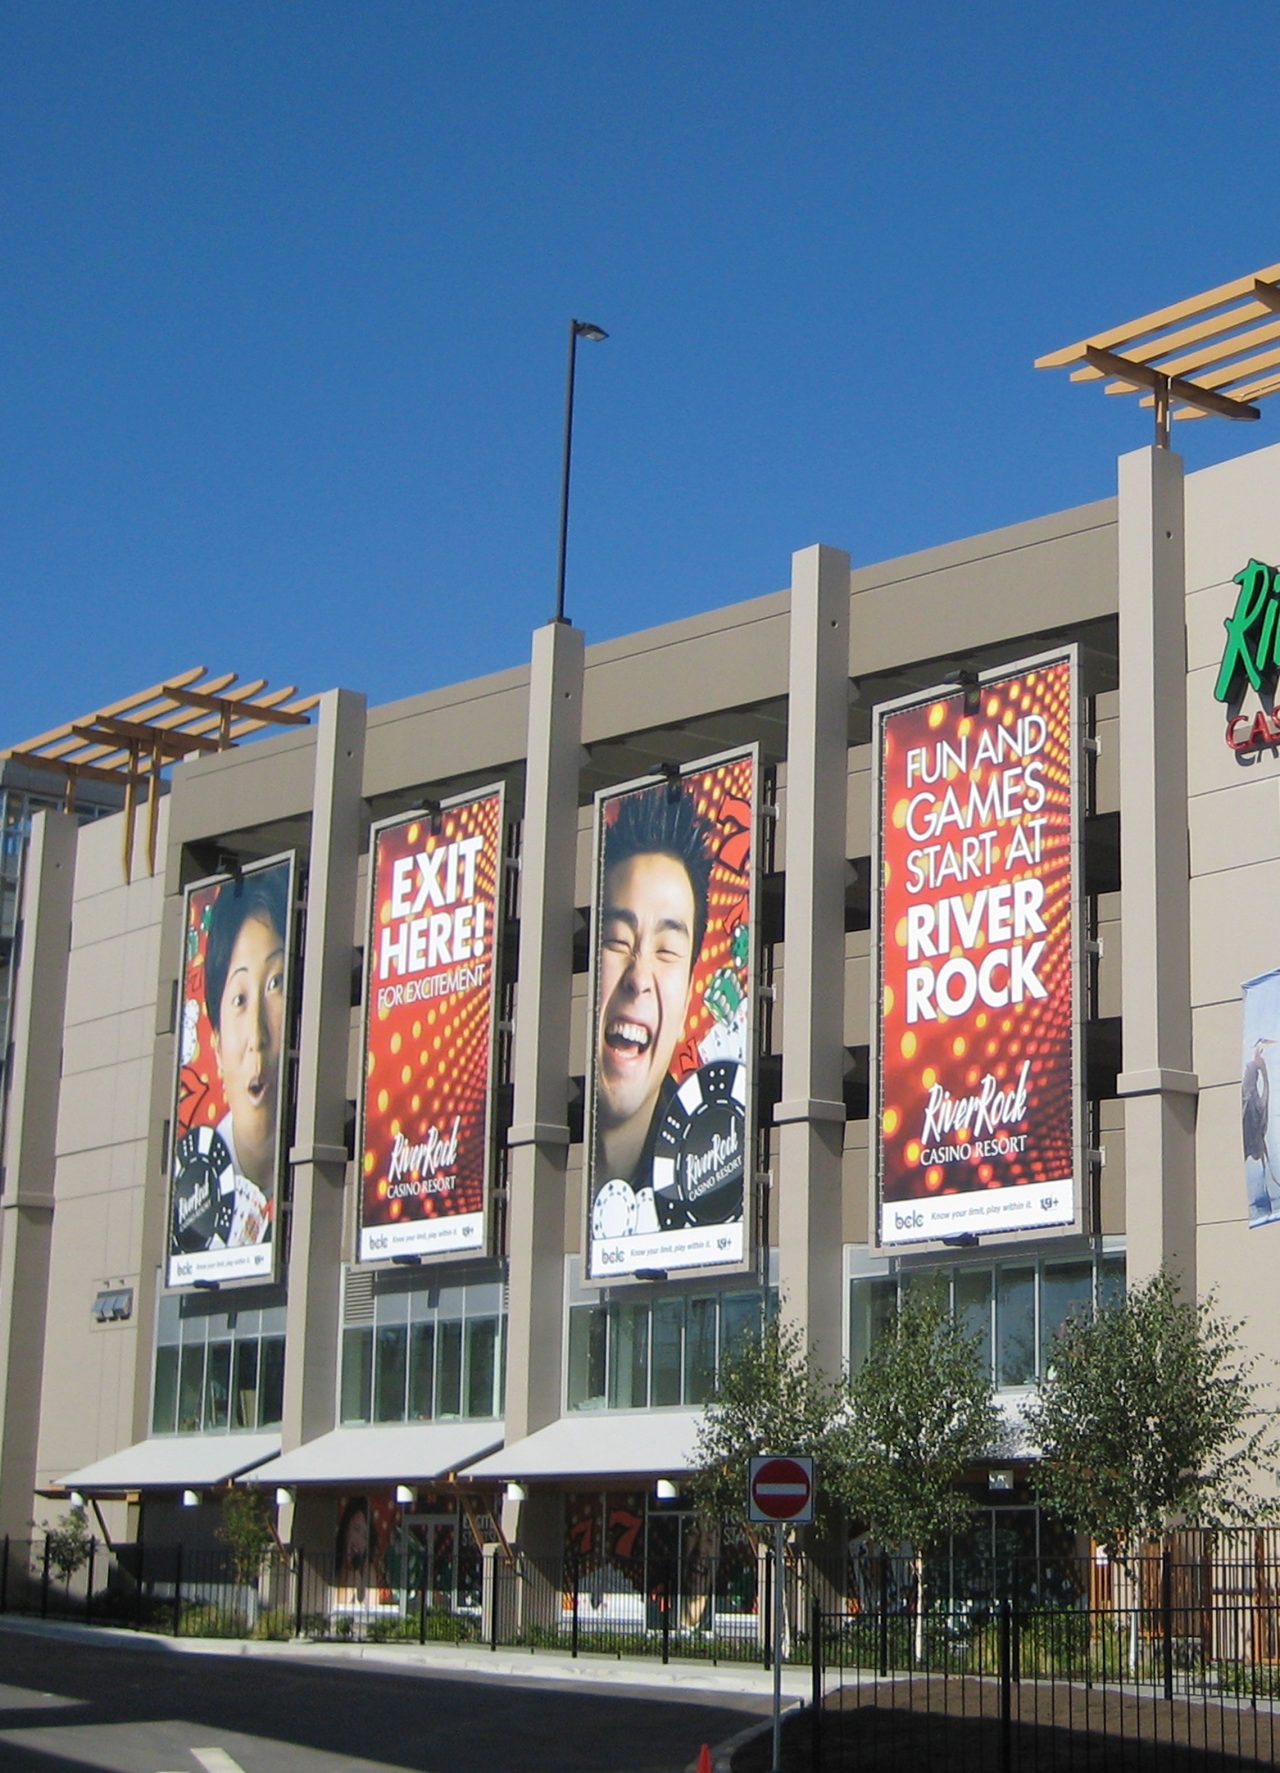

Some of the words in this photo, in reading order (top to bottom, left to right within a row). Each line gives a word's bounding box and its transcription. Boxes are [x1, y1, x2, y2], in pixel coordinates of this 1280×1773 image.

[907, 735, 967, 789] FUN
[973, 714, 1047, 769] AND
[905, 761, 1045, 842] GAMES
[391, 835, 484, 919] EXIT
[905, 830, 998, 894] START
[1005, 818, 1048, 871] AT
[379, 902, 485, 980] HERE!
[906, 877, 1047, 962] RIVER
[378, 986, 403, 1010] FOR
[404, 964, 485, 1004] EXCITEMENT
[906, 940, 1049, 1024] ROCK
[387, 1181, 420, 1199] CASINO
[421, 1175, 456, 1193] RESORT
[688, 1176, 715, 1201] CASINO
[716, 1155, 742, 1182] RESORT
[920, 1143, 971, 1166] CASINO
[975, 1135, 1028, 1158] RESORT
[895, 1210, 924, 1230] bclc
[931, 1212, 950, 1221] Know
[951, 1209, 967, 1221] your
[986, 1204, 1001, 1216] play
[1002, 1201, 1025, 1211] within
[601, 1246, 625, 1265] bclc
